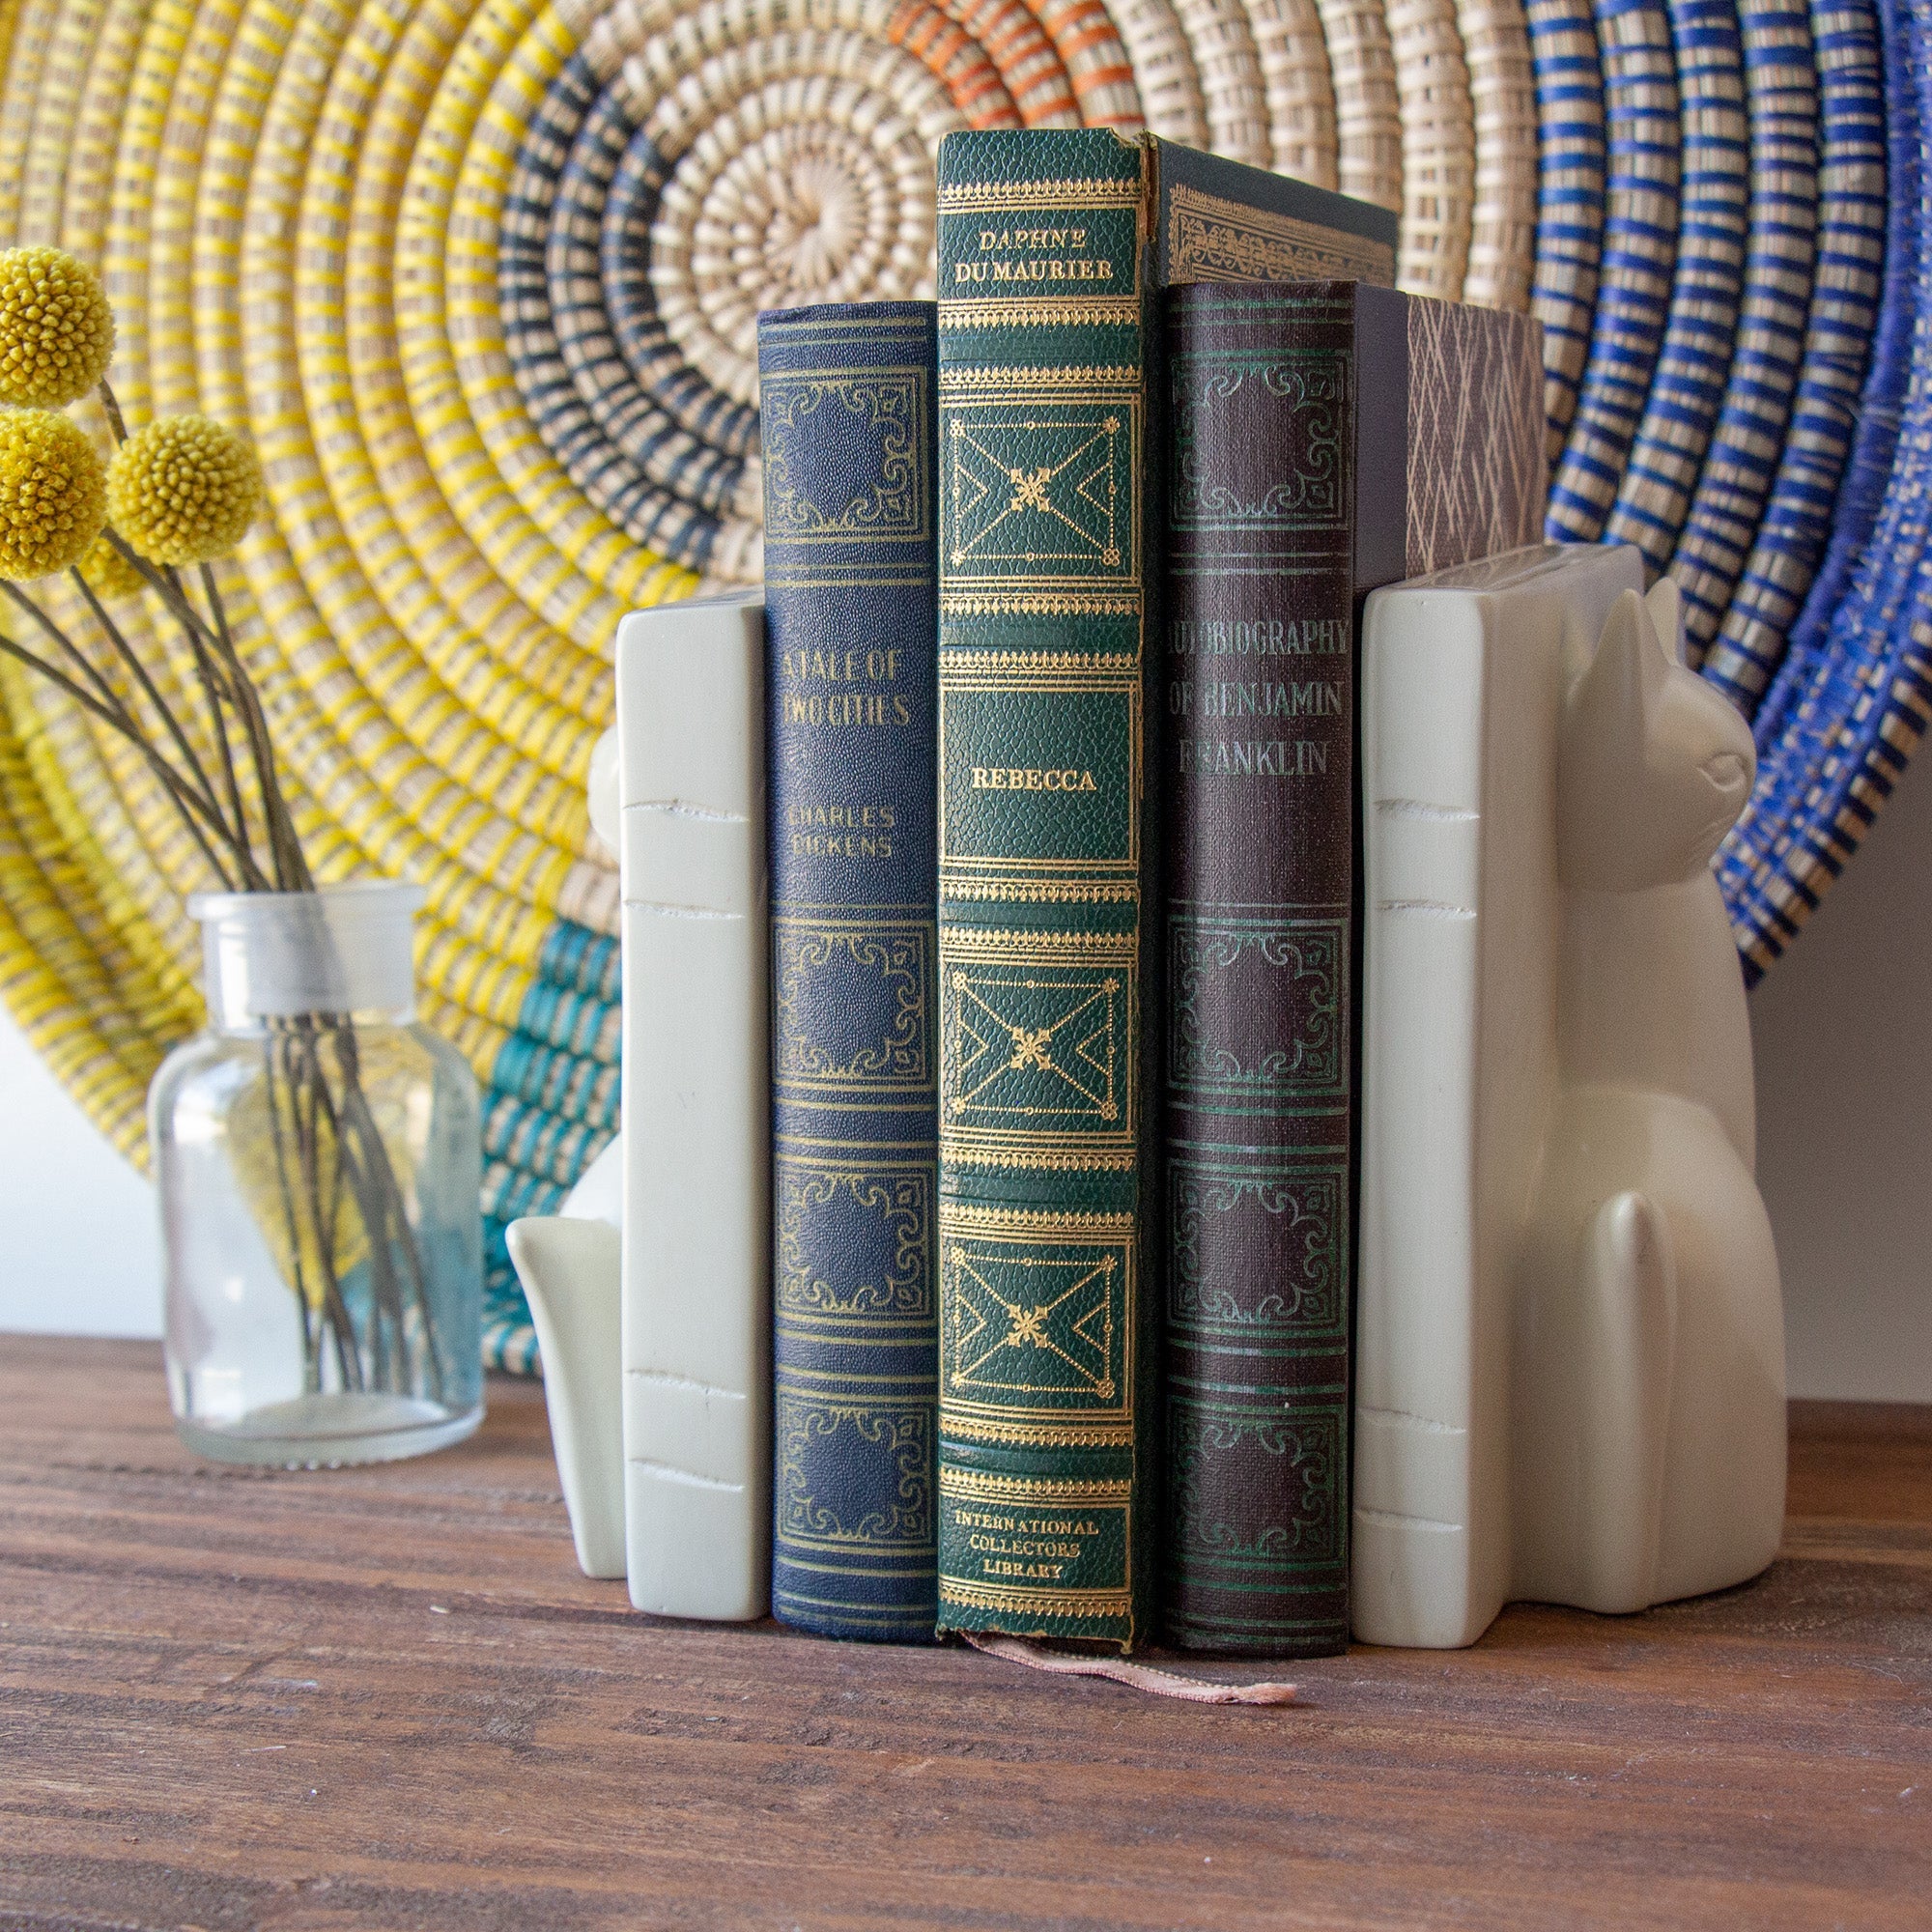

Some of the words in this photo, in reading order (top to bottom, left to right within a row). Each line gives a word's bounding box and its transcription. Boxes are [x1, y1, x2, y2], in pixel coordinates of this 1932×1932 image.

[979, 229, 1087, 251] DAPHNE
[954, 261, 988, 283] DU
[992, 259, 1114, 281] MAURIER
[797, 649, 860, 681] TALE
[866, 648, 902, 680] OF
[781, 694, 821, 725] TWO
[828, 694, 910, 726] CITIES
[1169, 681, 1194, 716] OF
[1205, 680, 1346, 717] BENJAMIN
[1179, 740, 1330, 776] FRANKLIN
[971, 767, 1097, 791] REBECCA
[786, 806, 895, 829] CHARLES
[791, 833, 893, 859] DICKENS
[955, 1510, 1099, 1535] INTERNATIONAL
[969, 1534, 1081, 1558] COLLECTORS
[982, 1558, 1064, 1579] LIBRARY
